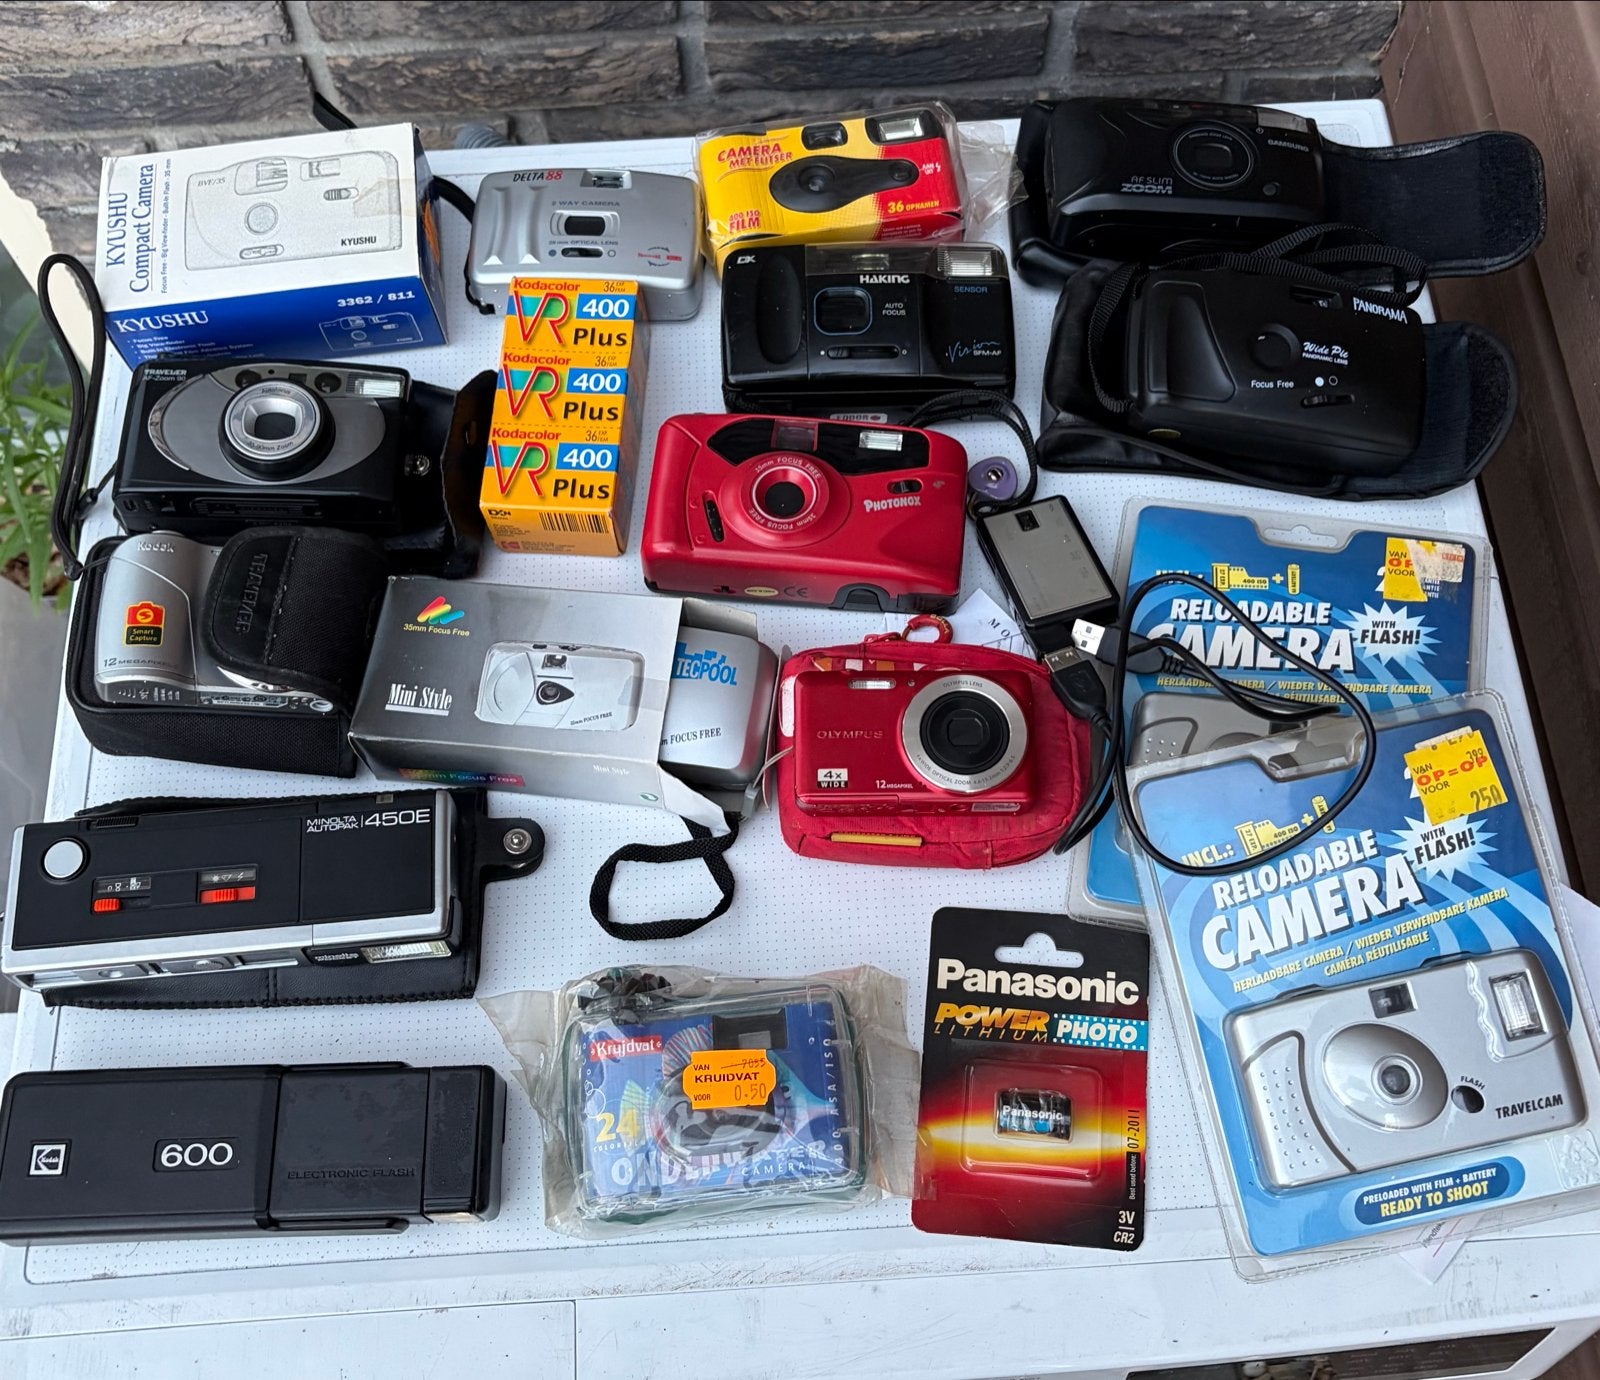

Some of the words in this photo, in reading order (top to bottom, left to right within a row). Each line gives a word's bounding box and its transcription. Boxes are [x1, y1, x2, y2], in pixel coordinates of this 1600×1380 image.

[718, 143, 781, 161] CAMERA
[1268, 138, 1309, 152] SAMSUNG
[730, 158, 752, 167] MET
[513, 172, 544, 182] DELTA
[1146, 177, 1173, 185] SLIM
[132, 164, 153, 219] Camera
[1121, 183, 1173, 194] ZOOM
[888, 201, 904, 213] 36
[106, 192, 128, 267] KYUSHU
[730, 217, 759, 234] FILM
[341, 235, 377, 246] KYUSHU
[130, 221, 156, 292] Compact
[514, 279, 580, 291] Kodacolor
[604, 282, 615, 293] 36
[860, 274, 910, 284] HAKING
[337, 294, 373, 308] 3362
[387, 290, 415, 301] 811
[513, 290, 569, 344] VR
[582, 299, 629, 318] 400
[1352, 297, 1408, 324] PANORAMA
[114, 310, 209, 333] KYUSHU
[573, 327, 627, 346] Plus
[1303, 342, 1330, 355] Wide
[1331, 345, 1349, 358] Pic
[504, 352, 571, 365] Kodacolor
[595, 356, 607, 367] 36
[503, 364, 560, 418] VR
[573, 373, 621, 392] 400
[1251, 380, 1274, 389] Focus
[1277, 380, 1294, 389] Free
[563, 401, 619, 420] Plus
[492, 428, 561, 440] Kodacolor
[586, 430, 597, 441] 36
[491, 439, 550, 496] VR
[563, 449, 612, 469] 400
[778, 457, 802, 465] FOCUS
[805, 463, 821, 479] FREE
[553, 478, 610, 499] Plus
[863, 496, 921, 512] PHOTONOX
[767, 521, 793, 530] FOCUS
[137, 542, 174, 553] Kodak
[1388, 568, 1415, 576] VOOR
[1170, 599, 1332, 625] RELOADABLE
[132, 628, 154, 636] Smart
[403, 623, 426, 633] 35mm
[428, 625, 450, 636] Focus
[452, 628, 470, 637] Free
[1372, 620, 1396, 629] WITH
[129, 635, 158, 643] Capture
[1360, 629, 1422, 646] FLASH!
[1147, 623, 1356, 672] CAMERA
[103, 658, 117, 667] 12
[676, 659, 737, 686] TECPOOL
[942, 680, 969, 688] OLYMPUS
[970, 680, 983, 688] LENS
[1277, 680, 1315, 690] WIEDER
[1391, 684, 1433, 694] KAMERA
[389, 683, 416, 707] Mini
[419, 686, 452, 711] Style
[583, 715, 599, 723] FOCUS
[670, 731, 697, 744] FOCUS
[700, 727, 721, 739] FREE
[817, 730, 883, 739] OLYMPUS
[1412, 763, 1433, 774] VAN
[1417, 755, 1488, 786] OP=OP
[876, 780, 886, 788] 12
[1421, 781, 1450, 795] VOOR
[306, 815, 357, 826] MINOLTA
[365, 809, 431, 827] 450E
[306, 822, 358, 832] AUTOPAK
[1420, 826, 1447, 844] WITH
[1414, 828, 1476, 865] FLASH!
[1212, 829, 1379, 911] RELOADABLE
[1202, 853, 1424, 971] CAMERA
[1233, 960, 1302, 993] HERLAADBARE
[1303, 946, 1344, 970] CAMERA
[1354, 928, 1393, 951] WIEDER
[1394, 903, 1466, 937] VERWENDBARE
[1466, 887, 1509, 911] KAMERA
[1366, 930, 1430, 961] RÉUTILISABLE
[937, 957, 1140, 1007] Panasonic
[934, 1002, 1051, 1032] POWER
[933, 1025, 1049, 1043] LITHIUM
[1056, 1019, 1139, 1044] PHOTO
[695, 1072, 759, 1083] KRUIDVAT
[822, 1038, 840, 1115] ASA/ISO
[1460, 1075, 1486, 1090] FLASH
[735, 1083, 766, 1101] 0.50
[1002, 1105, 1064, 1121] Panasonic
[1495, 1093, 1564, 1120] TRAVELCAM
[596, 1108, 639, 1142] 24
[1127, 1110, 1140, 1148] 07-2011
[160, 1141, 234, 1169] 600
[286, 1167, 370, 1180] ELECTRONIC
[372, 1167, 416, 1178] FLASH
[741, 1161, 806, 1177] CAMERA
[1363, 1186, 1410, 1205] PRELOADED
[1411, 1182, 1433, 1194] WITH
[1434, 1177, 1454, 1189] FILM
[1461, 1167, 1497, 1183] BATTERY
[1380, 1198, 1423, 1218] READY
[1425, 1192, 1443, 1206] TO
[1447, 1180, 1489, 1202] SHOOT
[1119, 1210, 1135, 1224] 3V
[1114, 1231, 1135, 1244] CR2
